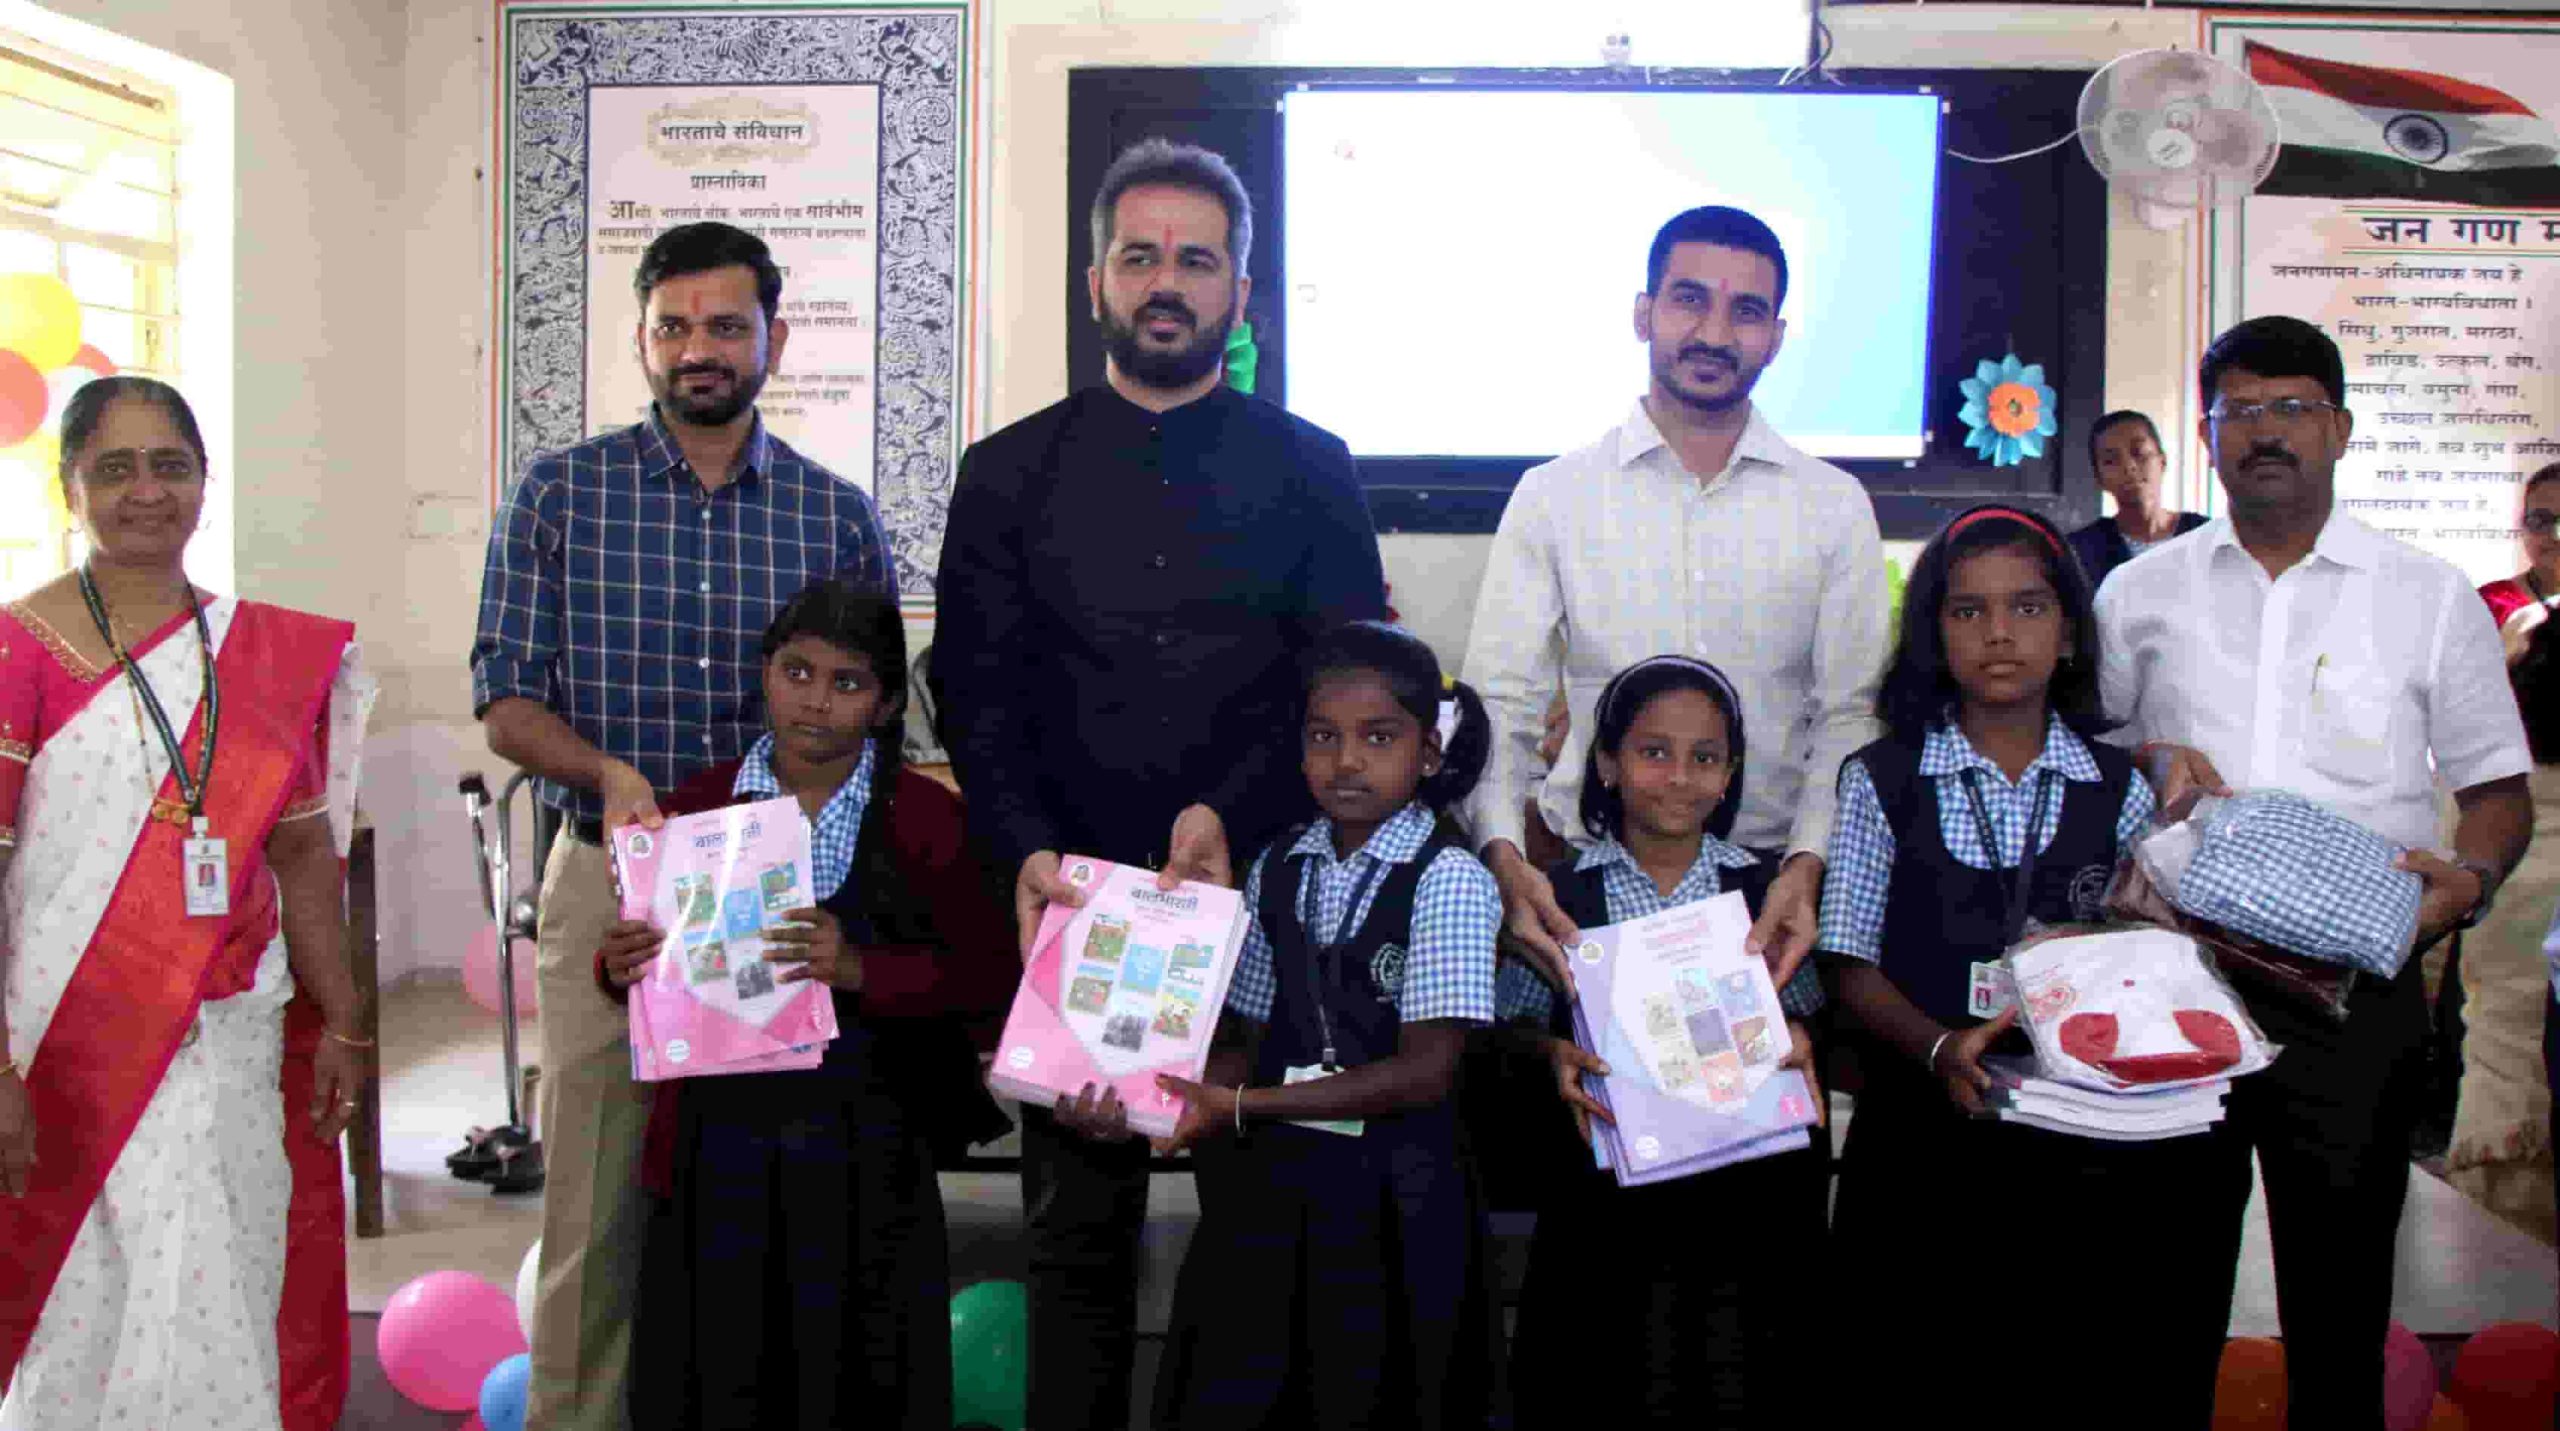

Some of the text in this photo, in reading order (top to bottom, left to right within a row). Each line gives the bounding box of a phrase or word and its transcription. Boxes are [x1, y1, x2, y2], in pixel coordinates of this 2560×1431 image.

[661, 120, 804, 140] भारताचे संविधान
[805, 199, 864, 218] सार्वभौम
[2361, 217, 2432, 244] जन
[2450, 219, 2522, 246] गण
[2472, 265, 2504, 282] जय
[2509, 261, 2524, 282] हे
